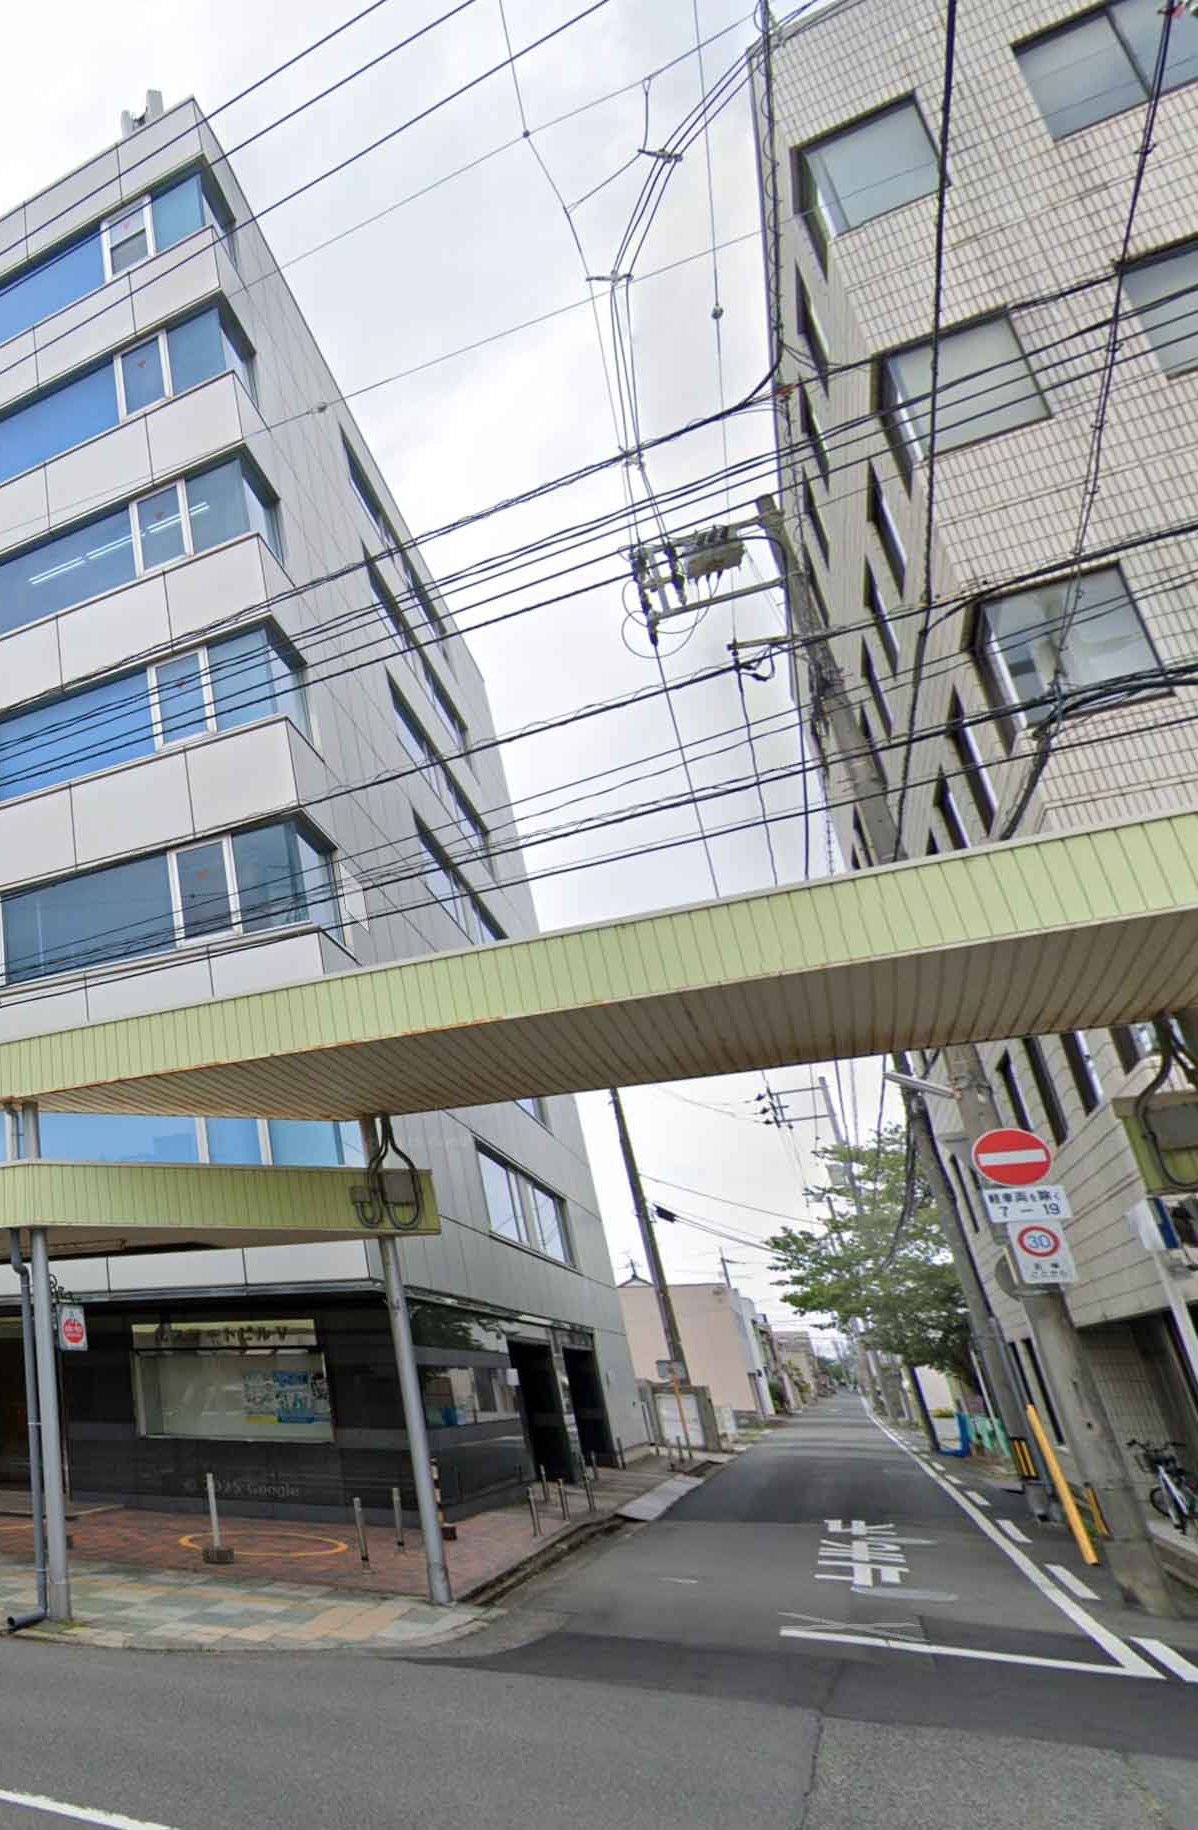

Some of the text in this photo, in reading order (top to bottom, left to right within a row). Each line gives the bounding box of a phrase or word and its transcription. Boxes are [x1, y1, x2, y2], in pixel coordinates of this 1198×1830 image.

[989, 1190, 1060, 1203] 軽車両を除く
[1027, 1234, 1051, 1249] 30
